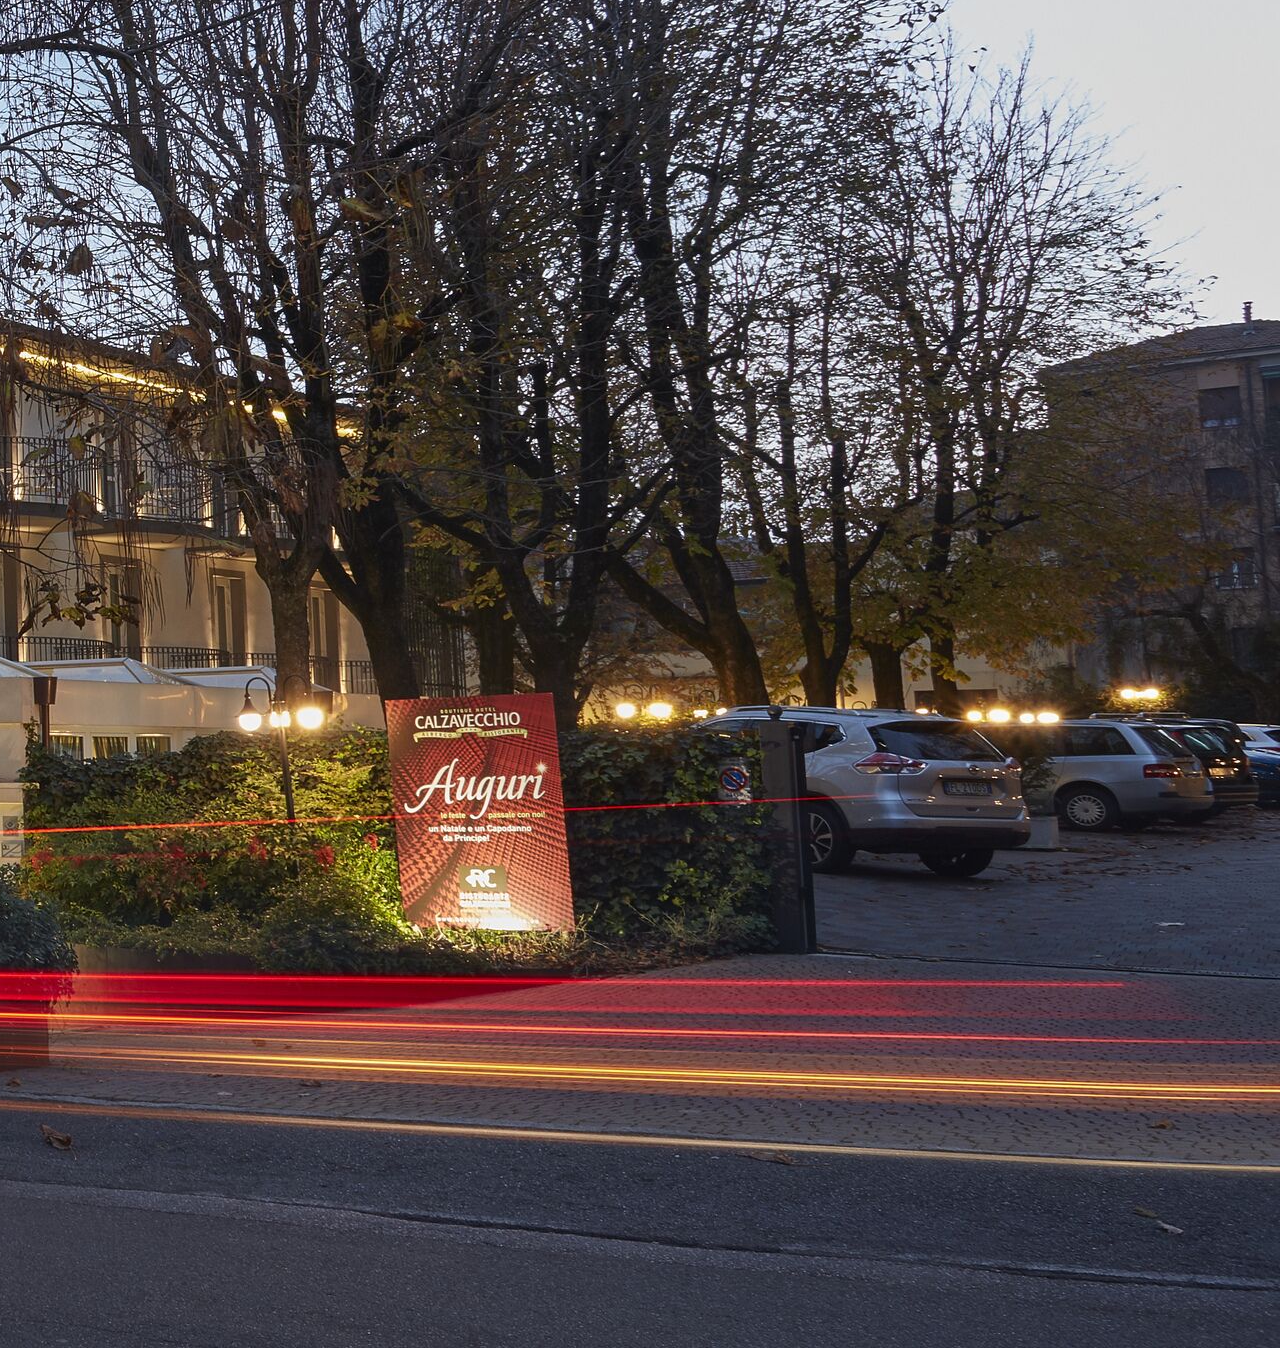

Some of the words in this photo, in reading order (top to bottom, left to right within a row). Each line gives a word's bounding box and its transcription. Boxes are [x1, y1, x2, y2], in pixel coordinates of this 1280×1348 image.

[415, 712, 520, 729] CALZAVECCHIO
[484, 729, 522, 737] RISTORANTE
[404, 758, 545, 820] Auguri
[487, 824, 532, 833] Capodanno
[454, 834, 490, 843] Principe!
